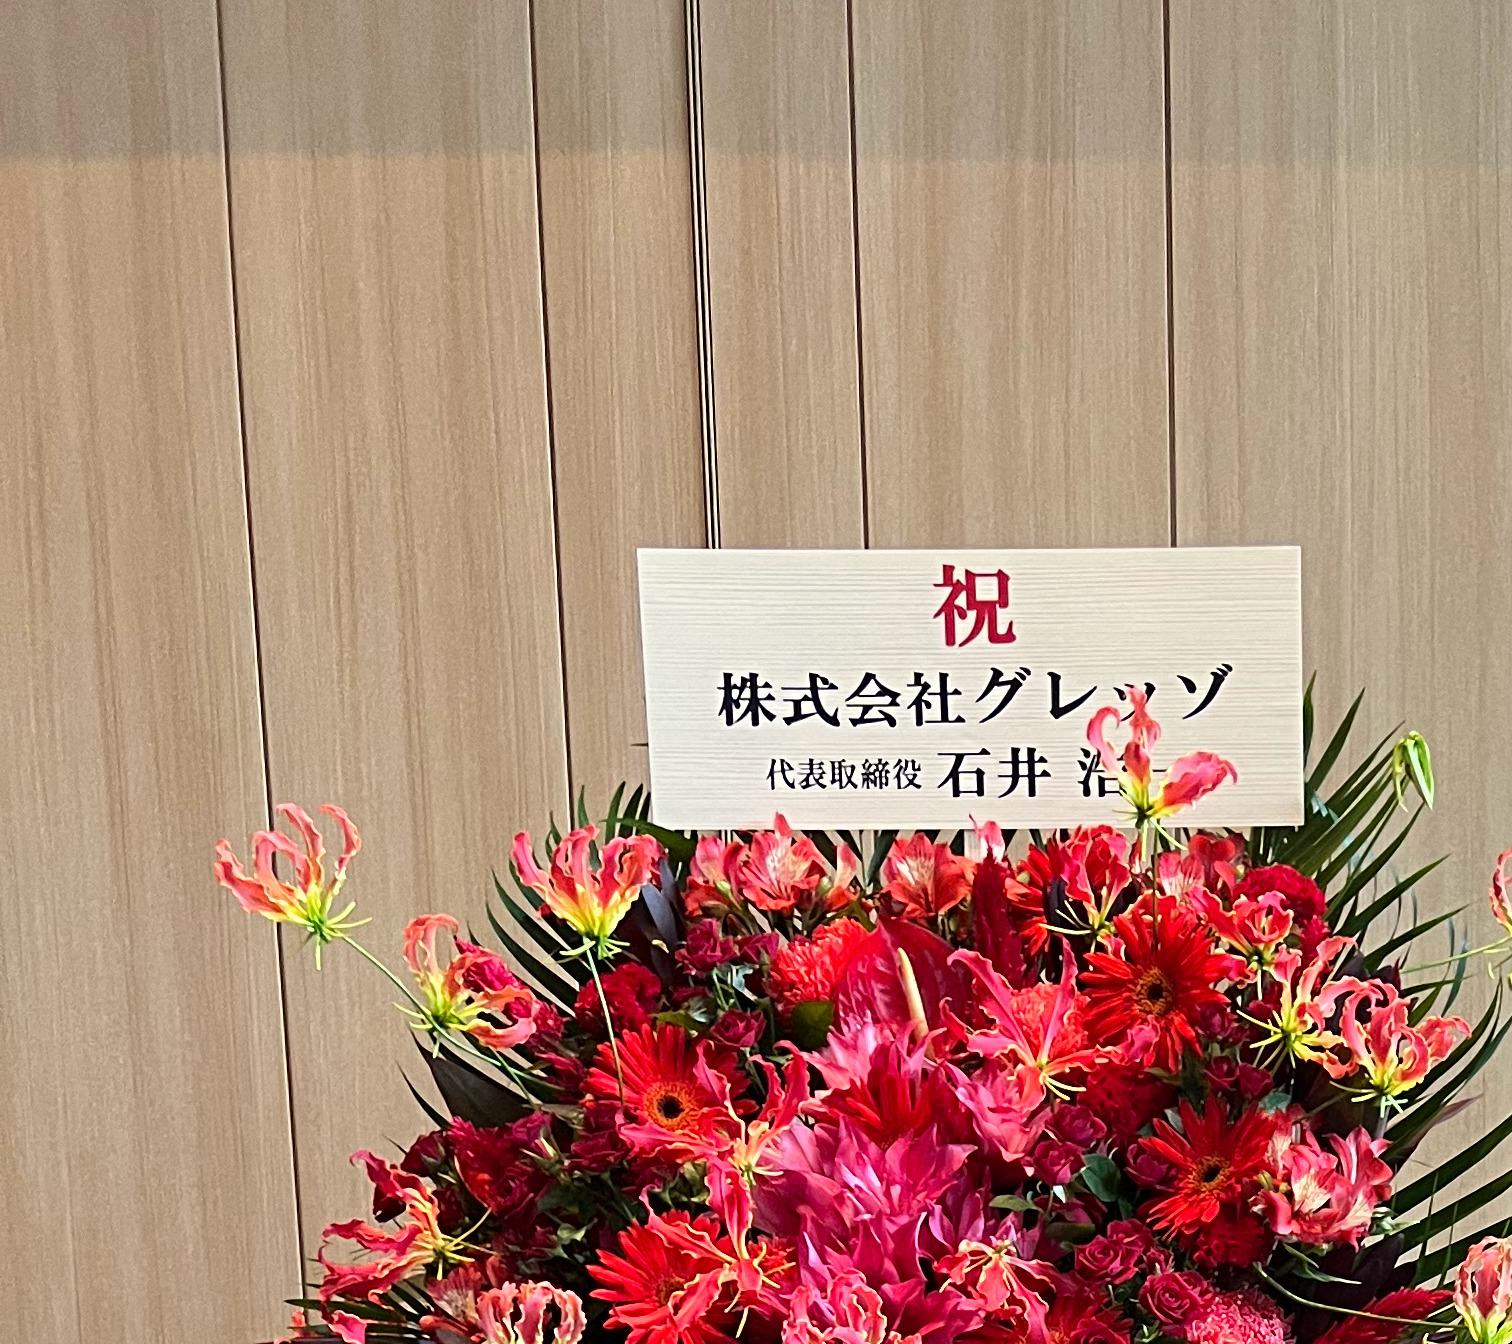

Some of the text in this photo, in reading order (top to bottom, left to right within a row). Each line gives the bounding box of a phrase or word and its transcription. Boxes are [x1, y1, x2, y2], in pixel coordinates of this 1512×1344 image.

[933, 564, 1017, 648] 祝
[716, 663, 1233, 728] 株式会社グレッゾ
[766, 757, 923, 790] 代表取締役
